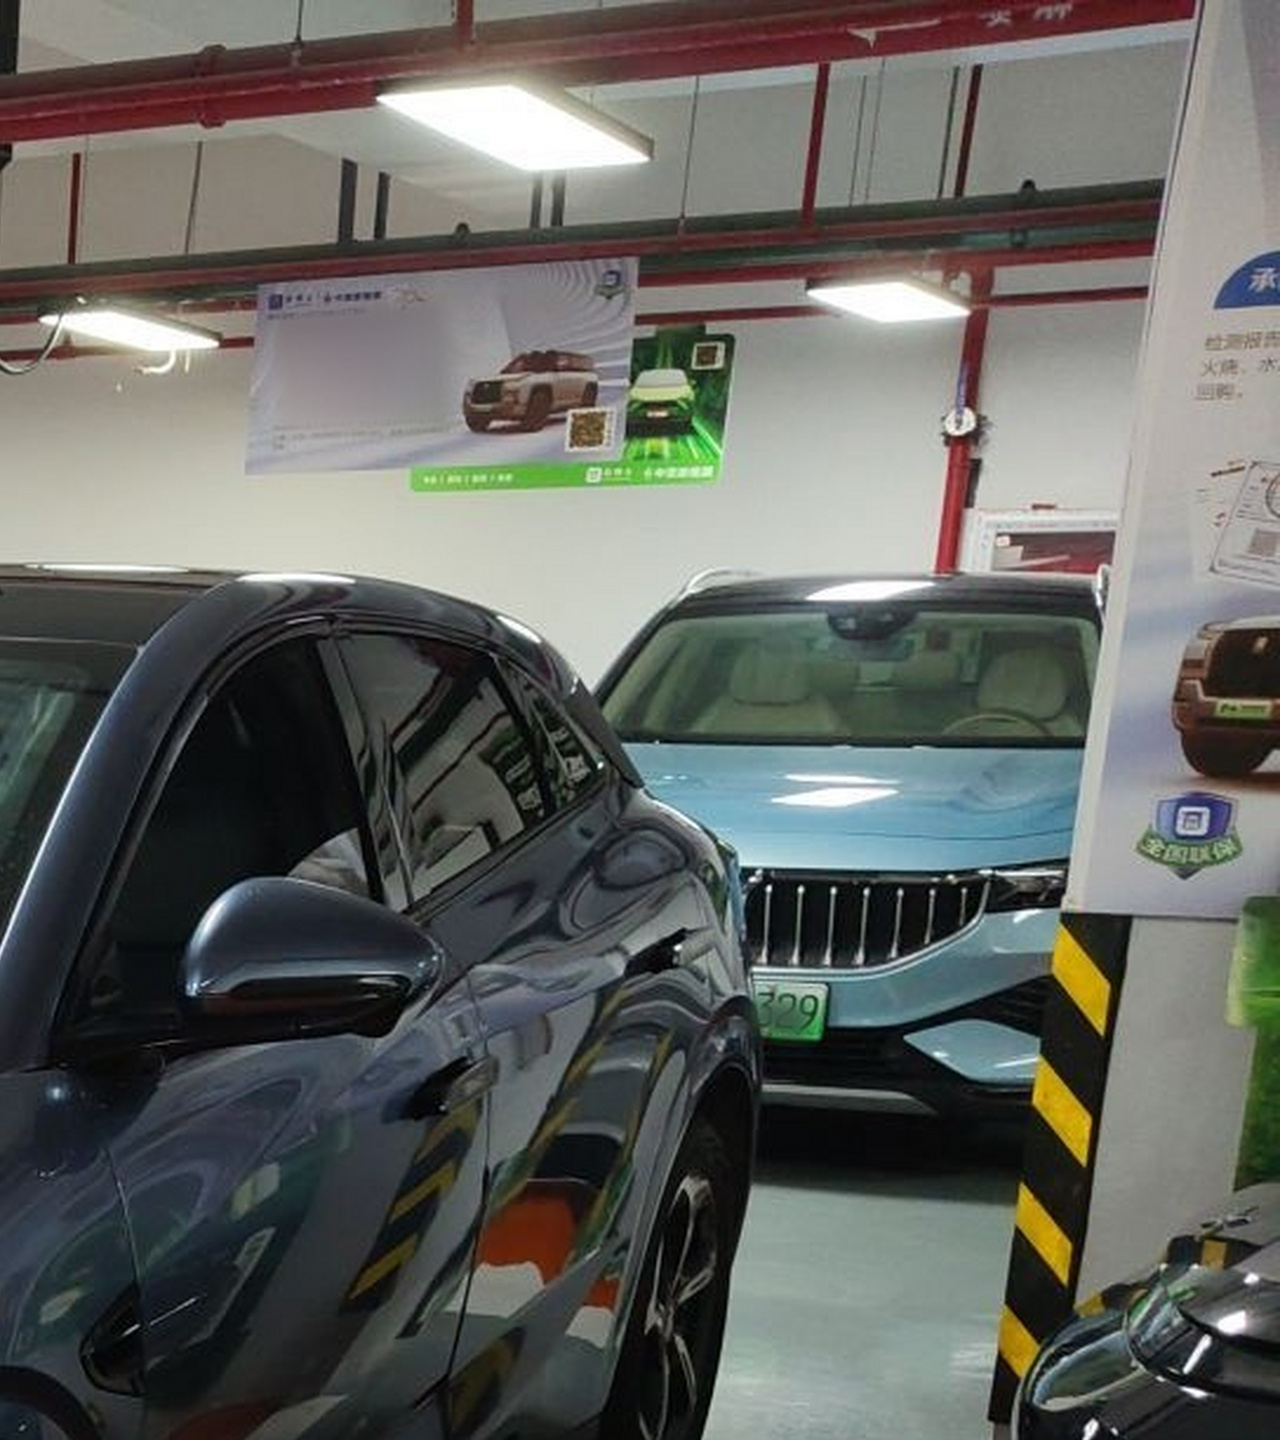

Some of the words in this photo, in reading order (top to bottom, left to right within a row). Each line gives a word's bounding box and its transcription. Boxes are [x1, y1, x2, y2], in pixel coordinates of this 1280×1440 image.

[1248, 266, 1280, 293] 承
[1200, 356, 1280, 377] 火烧、水
